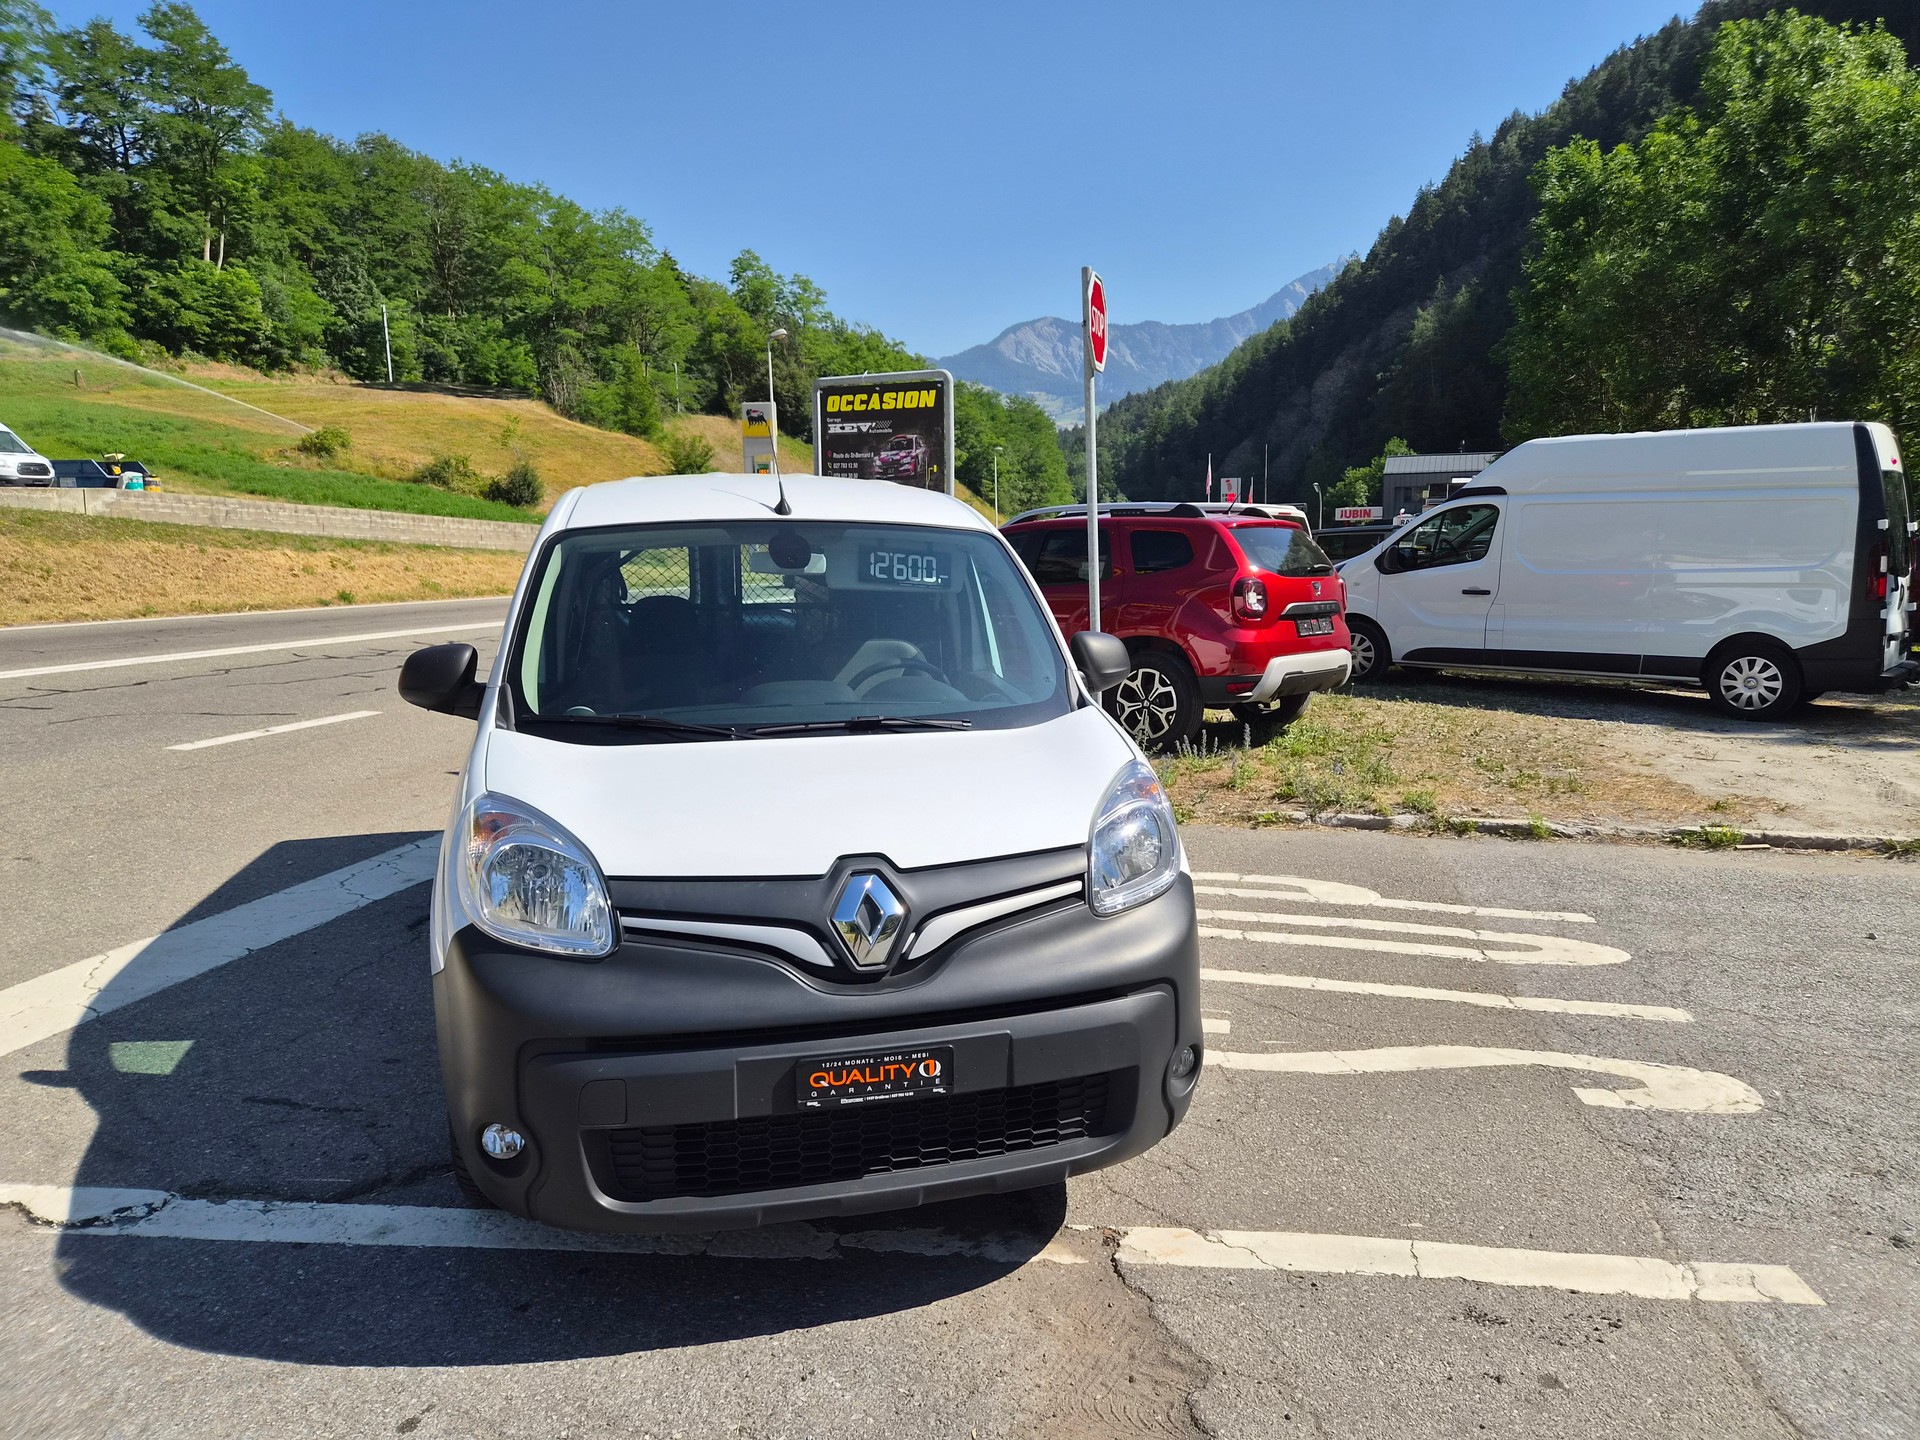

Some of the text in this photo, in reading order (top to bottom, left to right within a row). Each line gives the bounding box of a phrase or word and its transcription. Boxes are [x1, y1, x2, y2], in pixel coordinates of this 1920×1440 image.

[1091, 305, 1105, 339] STOP
[826, 389, 937, 413] OCCASION
[1340, 509, 1372, 519] JUBIN
[845, 1057, 875, 1066] MONATE
[809, 1062, 917, 1089] QUALITY
[811, 1078, 941, 1098] GARANTIE
